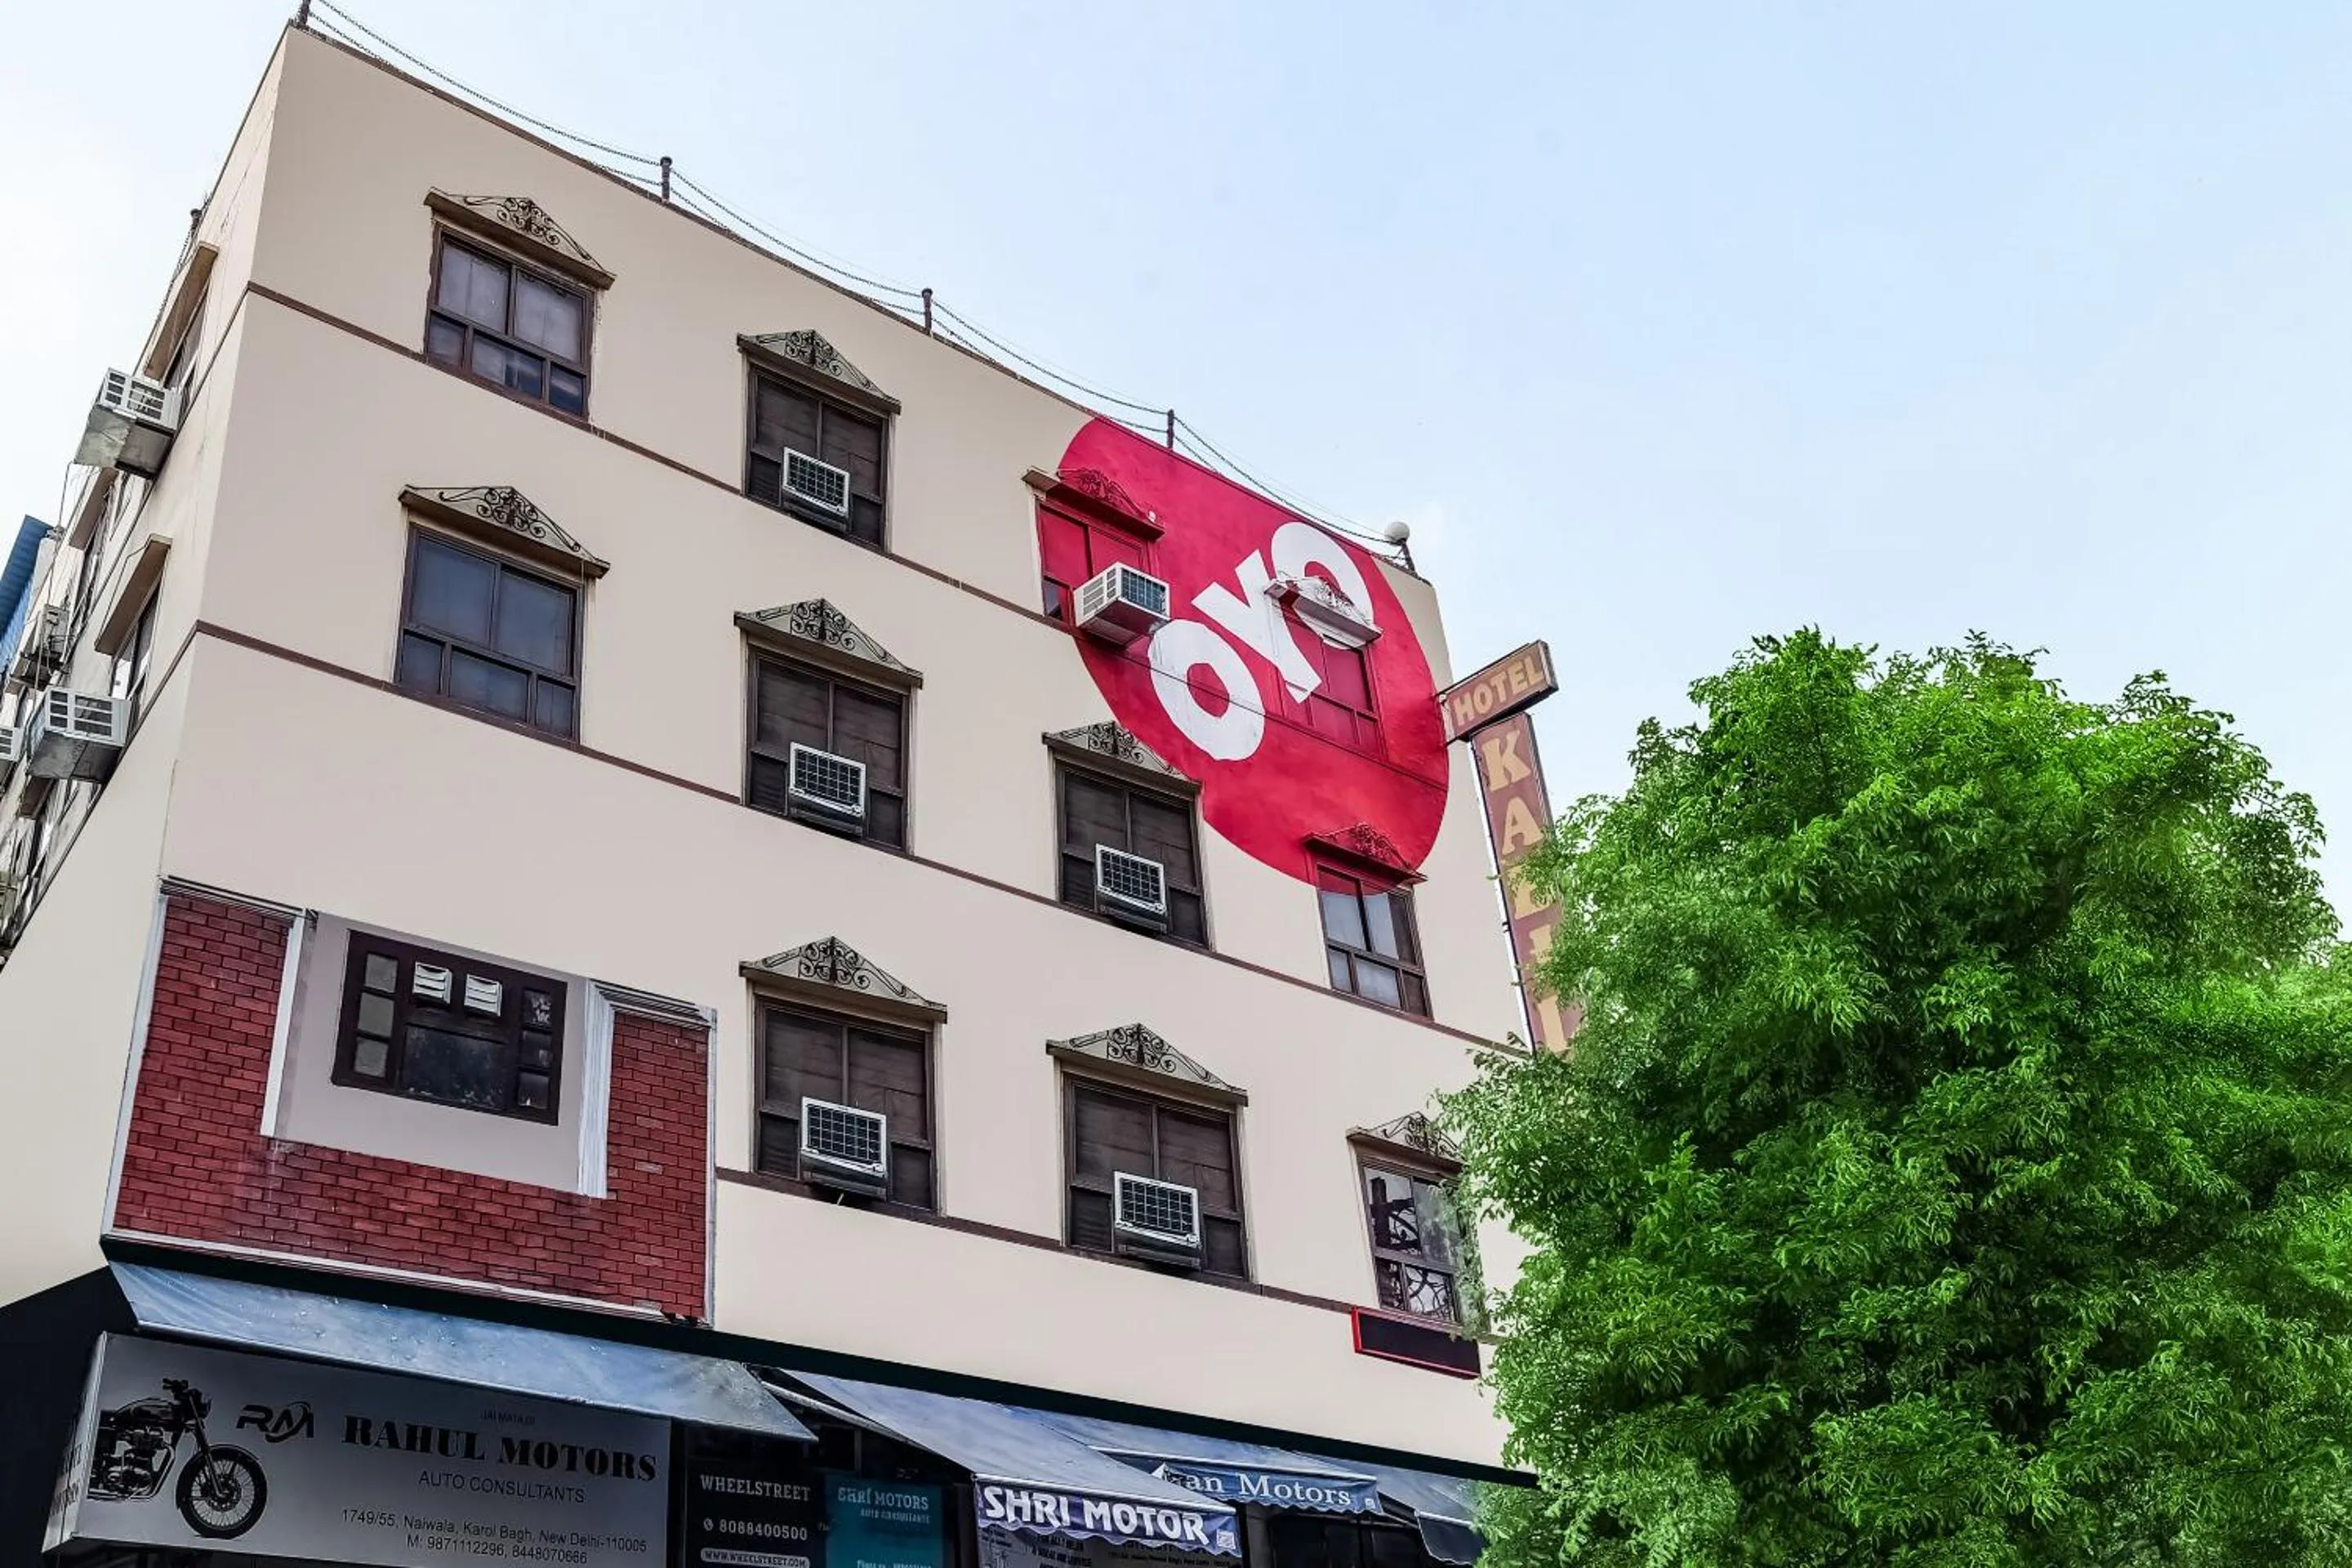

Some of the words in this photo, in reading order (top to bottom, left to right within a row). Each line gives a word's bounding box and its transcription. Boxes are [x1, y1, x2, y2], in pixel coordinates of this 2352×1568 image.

[1147, 521, 1375, 761] OYO
[1454, 655, 1545, 726] HOTEL
[235, 1401, 314, 1444] RM
[341, 1415, 485, 1461] RAHUL
[498, 1437, 657, 1482] MOTORS
[418, 1470, 465, 1490] AUTO
[470, 1476, 586, 1503] CONSULTANTS
[700, 1473, 811, 1502] WHEELSTREET
[874, 1490, 930, 1511] MOTORS
[1236, 1472, 1351, 1505] Motors
[463, 1521, 497, 1538] Karol
[539, 1530, 567, 1544] New
[719, 1518, 808, 1541] 8088400500
[983, 1486, 1071, 1529] SHRI
[1082, 1499, 1210, 1546] MOTOR
